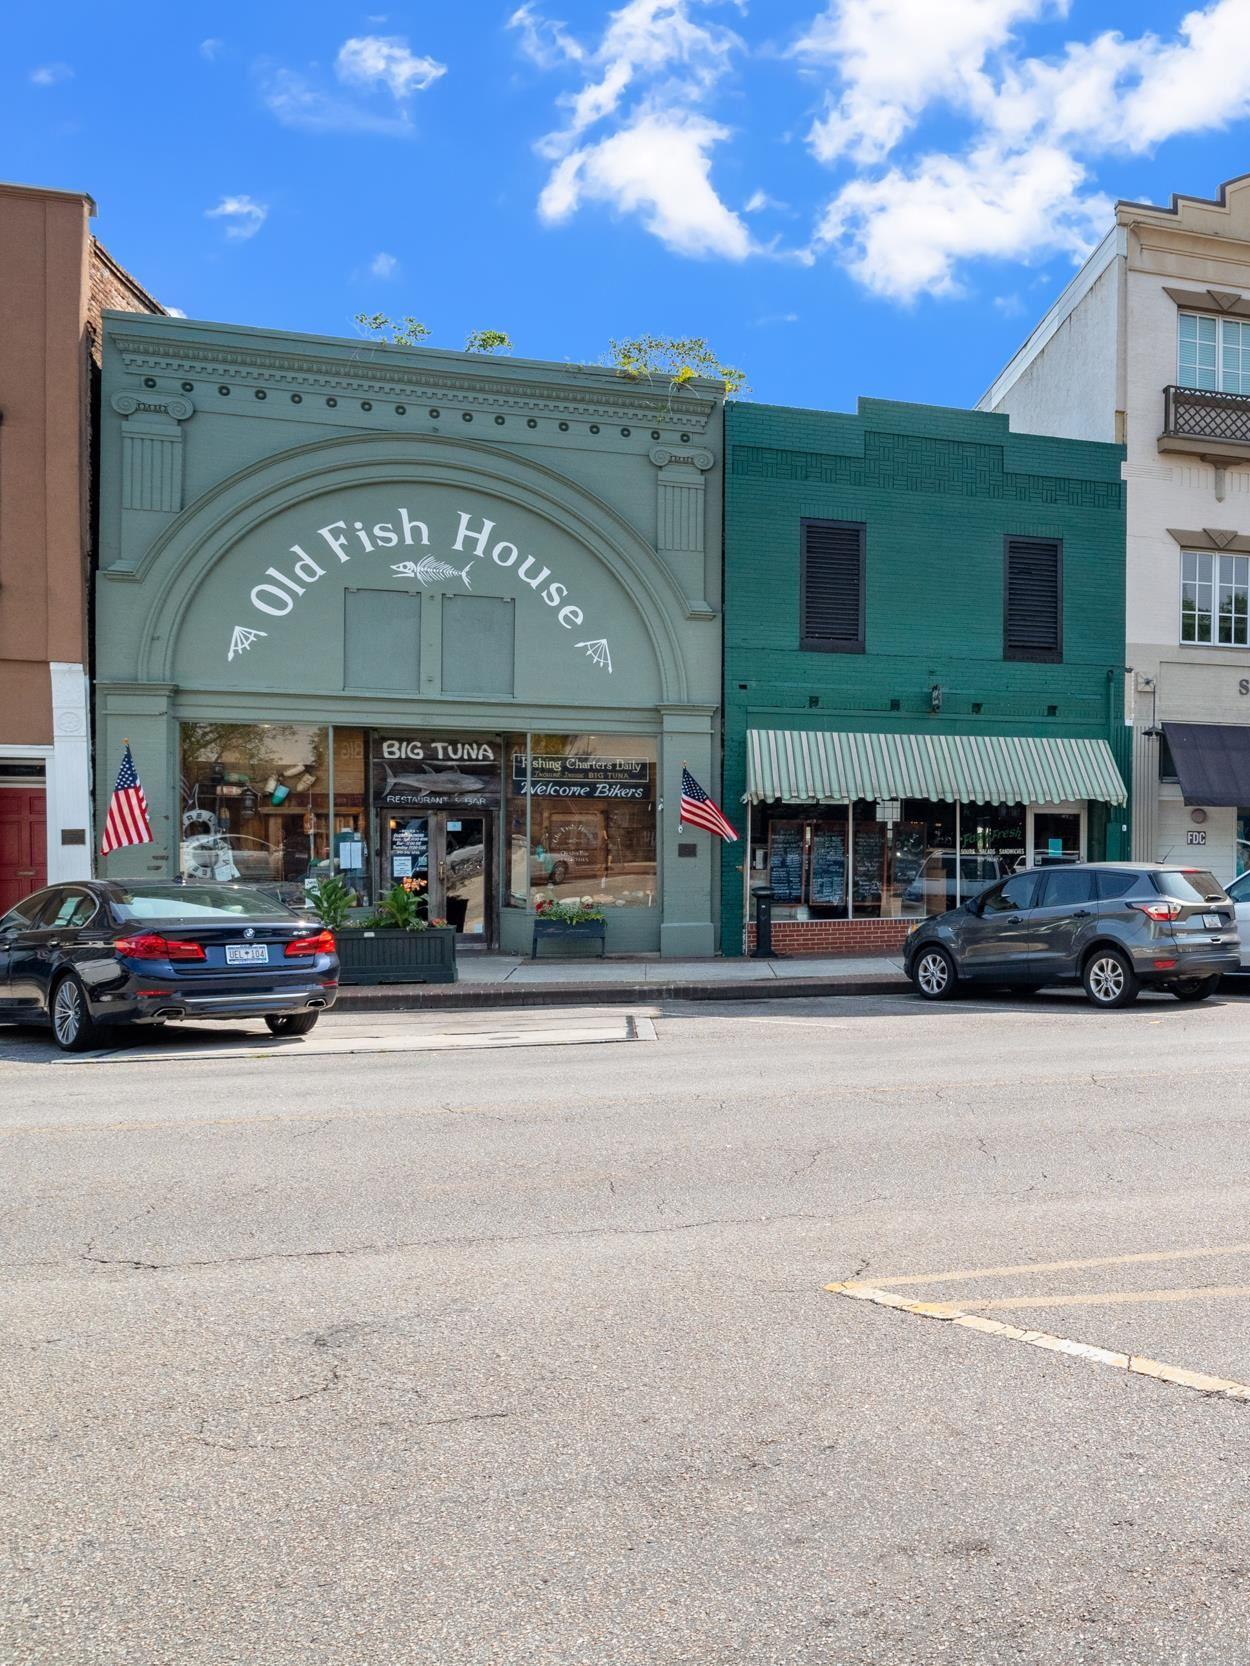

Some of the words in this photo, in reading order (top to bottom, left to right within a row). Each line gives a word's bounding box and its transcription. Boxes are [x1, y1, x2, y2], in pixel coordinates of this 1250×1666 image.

[250, 544, 327, 617] Old
[316, 508, 430, 563] Fish
[452, 510, 584, 630] House
[382, 740, 424, 759] BIG
[431, 742, 494, 760] TUNA
[521, 756, 562, 771] Fshing
[566, 758, 612, 771] Charters
[616, 759, 641, 773] Daily
[521, 781, 590, 796] Welcome
[593, 783, 643, 798] Bikers
[387, 795, 447, 804] RESTAURANT
[464, 797, 487, 805] BAR
[1187, 831, 1206, 844] FDC
[251, 949, 265, 959] 104
